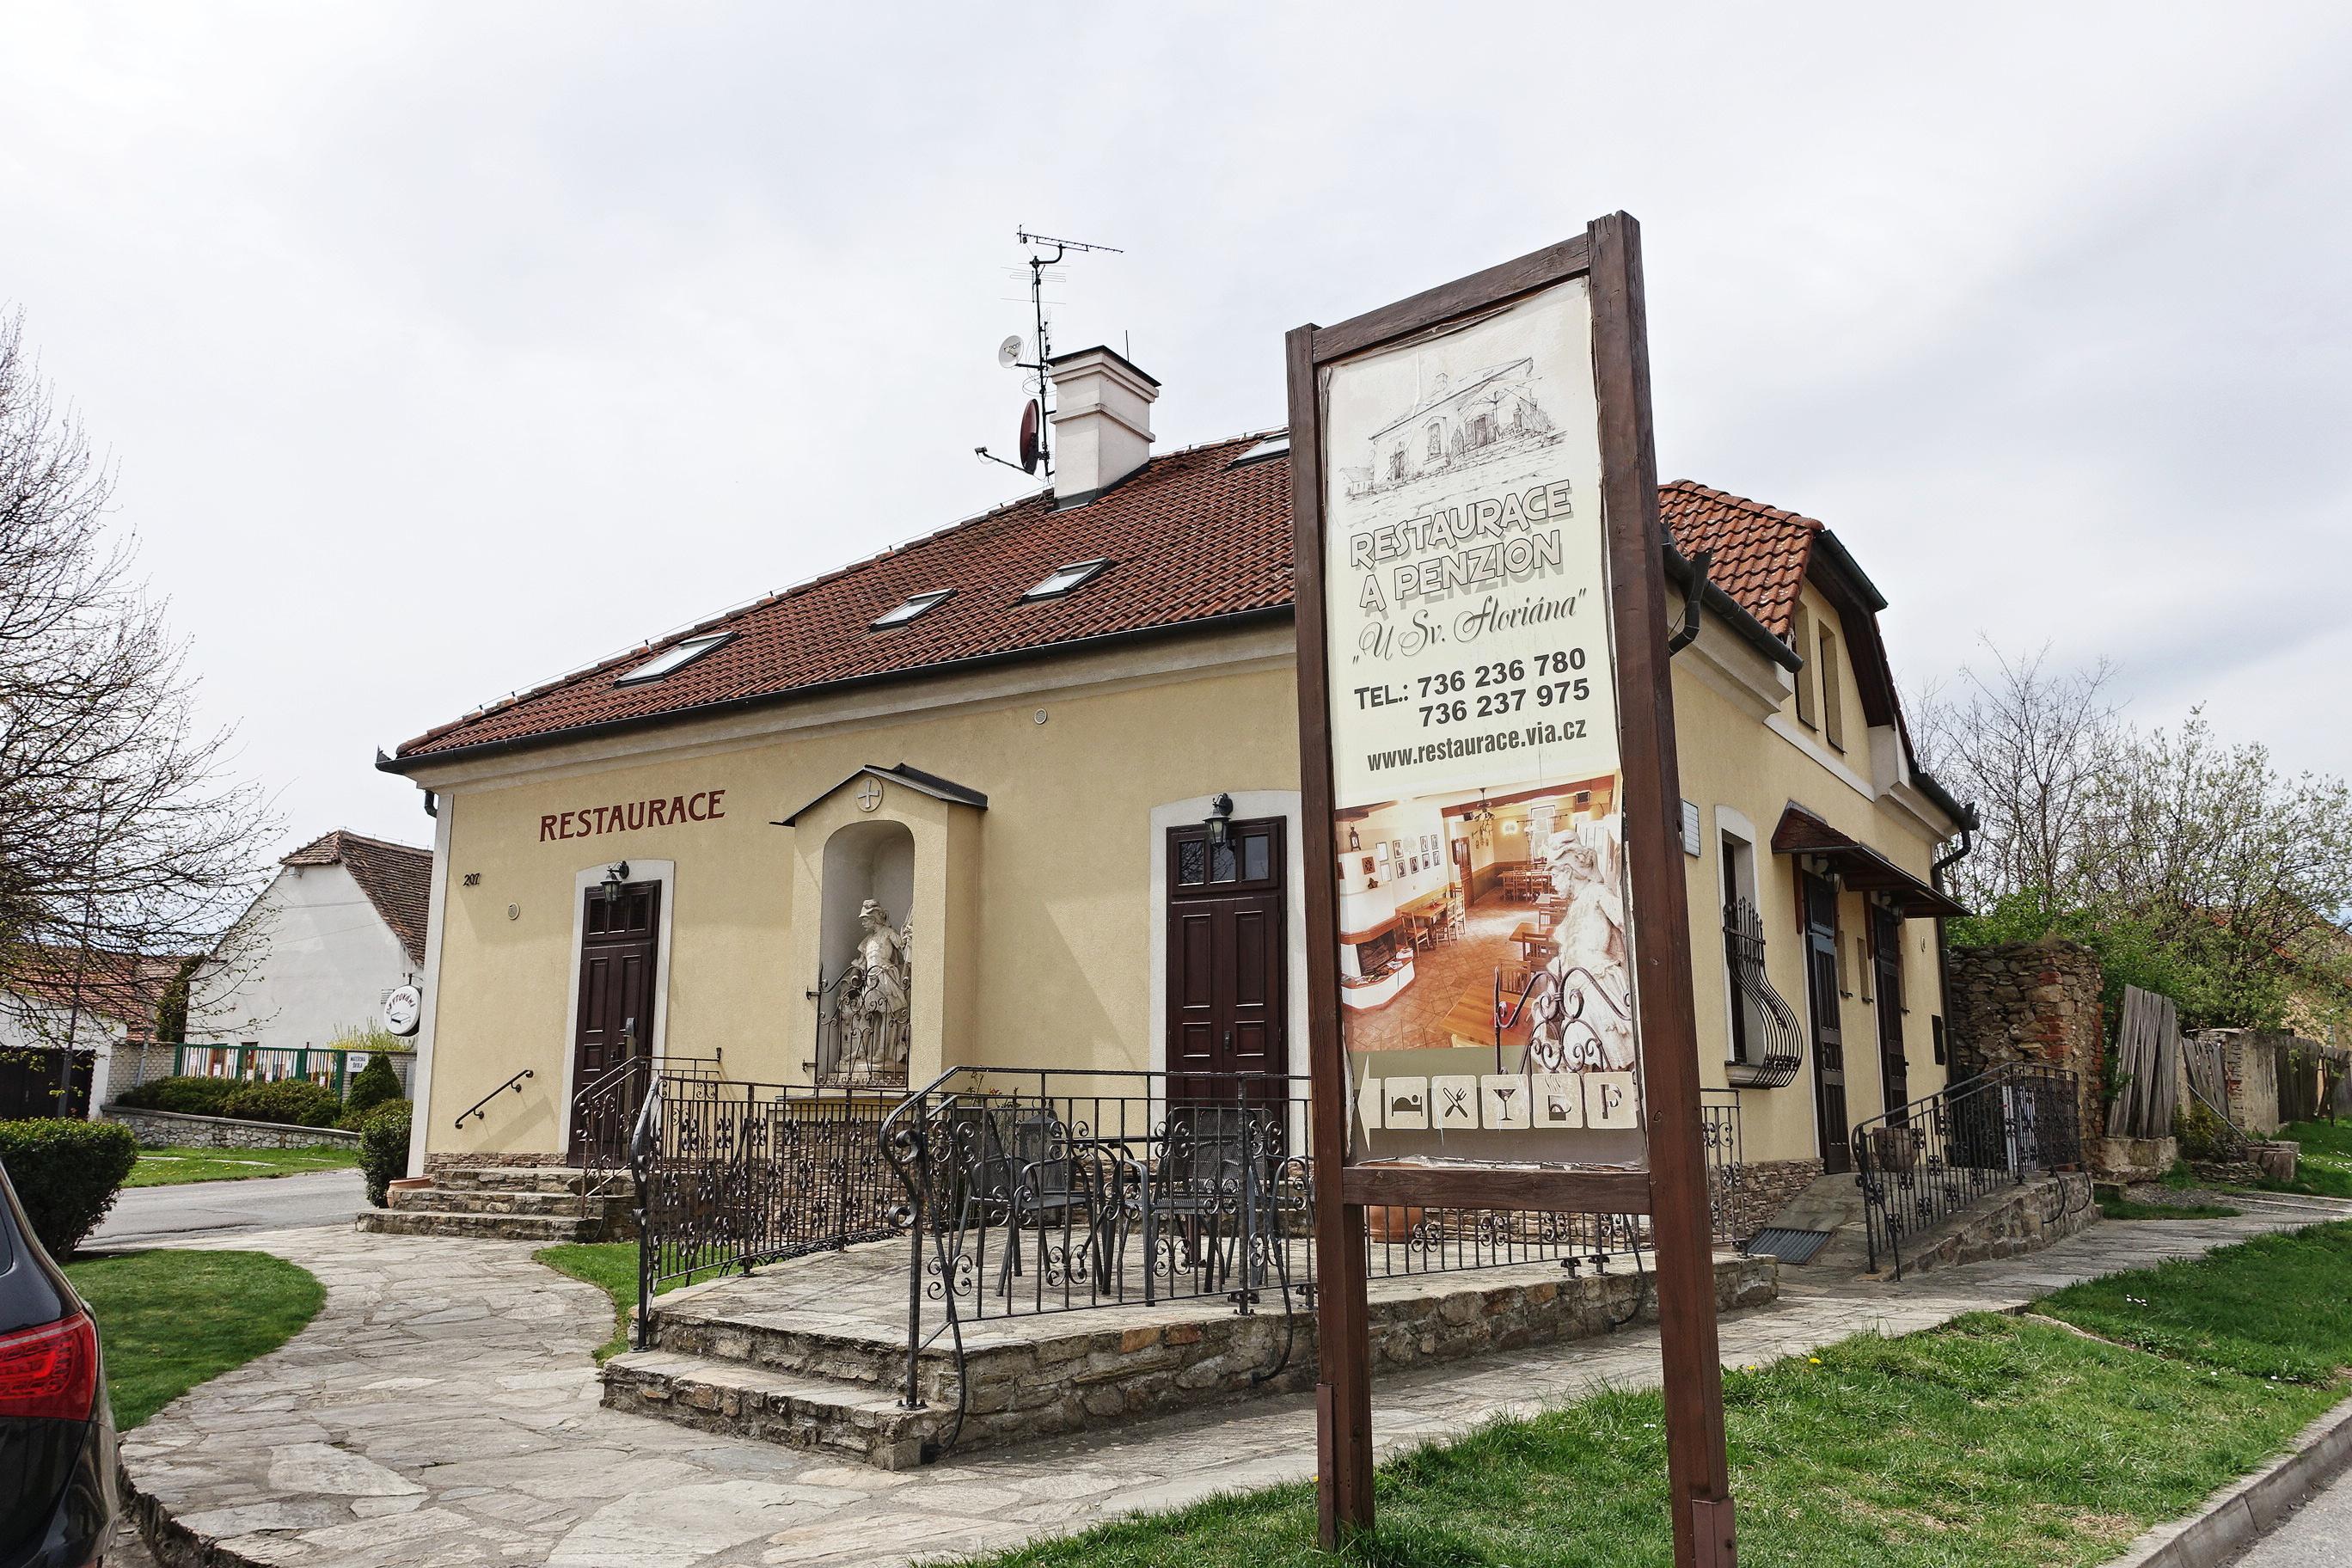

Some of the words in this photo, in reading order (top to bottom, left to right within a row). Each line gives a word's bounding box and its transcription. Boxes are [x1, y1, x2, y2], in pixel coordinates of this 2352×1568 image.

[1351, 480, 1571, 569] RESTAURACE
[1359, 574, 1387, 611] A
[1394, 530, 1561, 601] PENZION
[1398, 609, 1446, 657] Sv.
[1354, 683, 1409, 710] TEL.:
[1418, 670, 1465, 698] 736
[1474, 659, 1525, 689] 236
[1534, 647, 1586, 677] 780
[1419, 700, 1467, 727] 736
[1476, 689, 1527, 718] 237
[1536, 677, 1590, 707] 975
[1367, 719, 1587, 771] www.restaurace.via.cz
[539, 790, 726, 842] RESTAURACE
